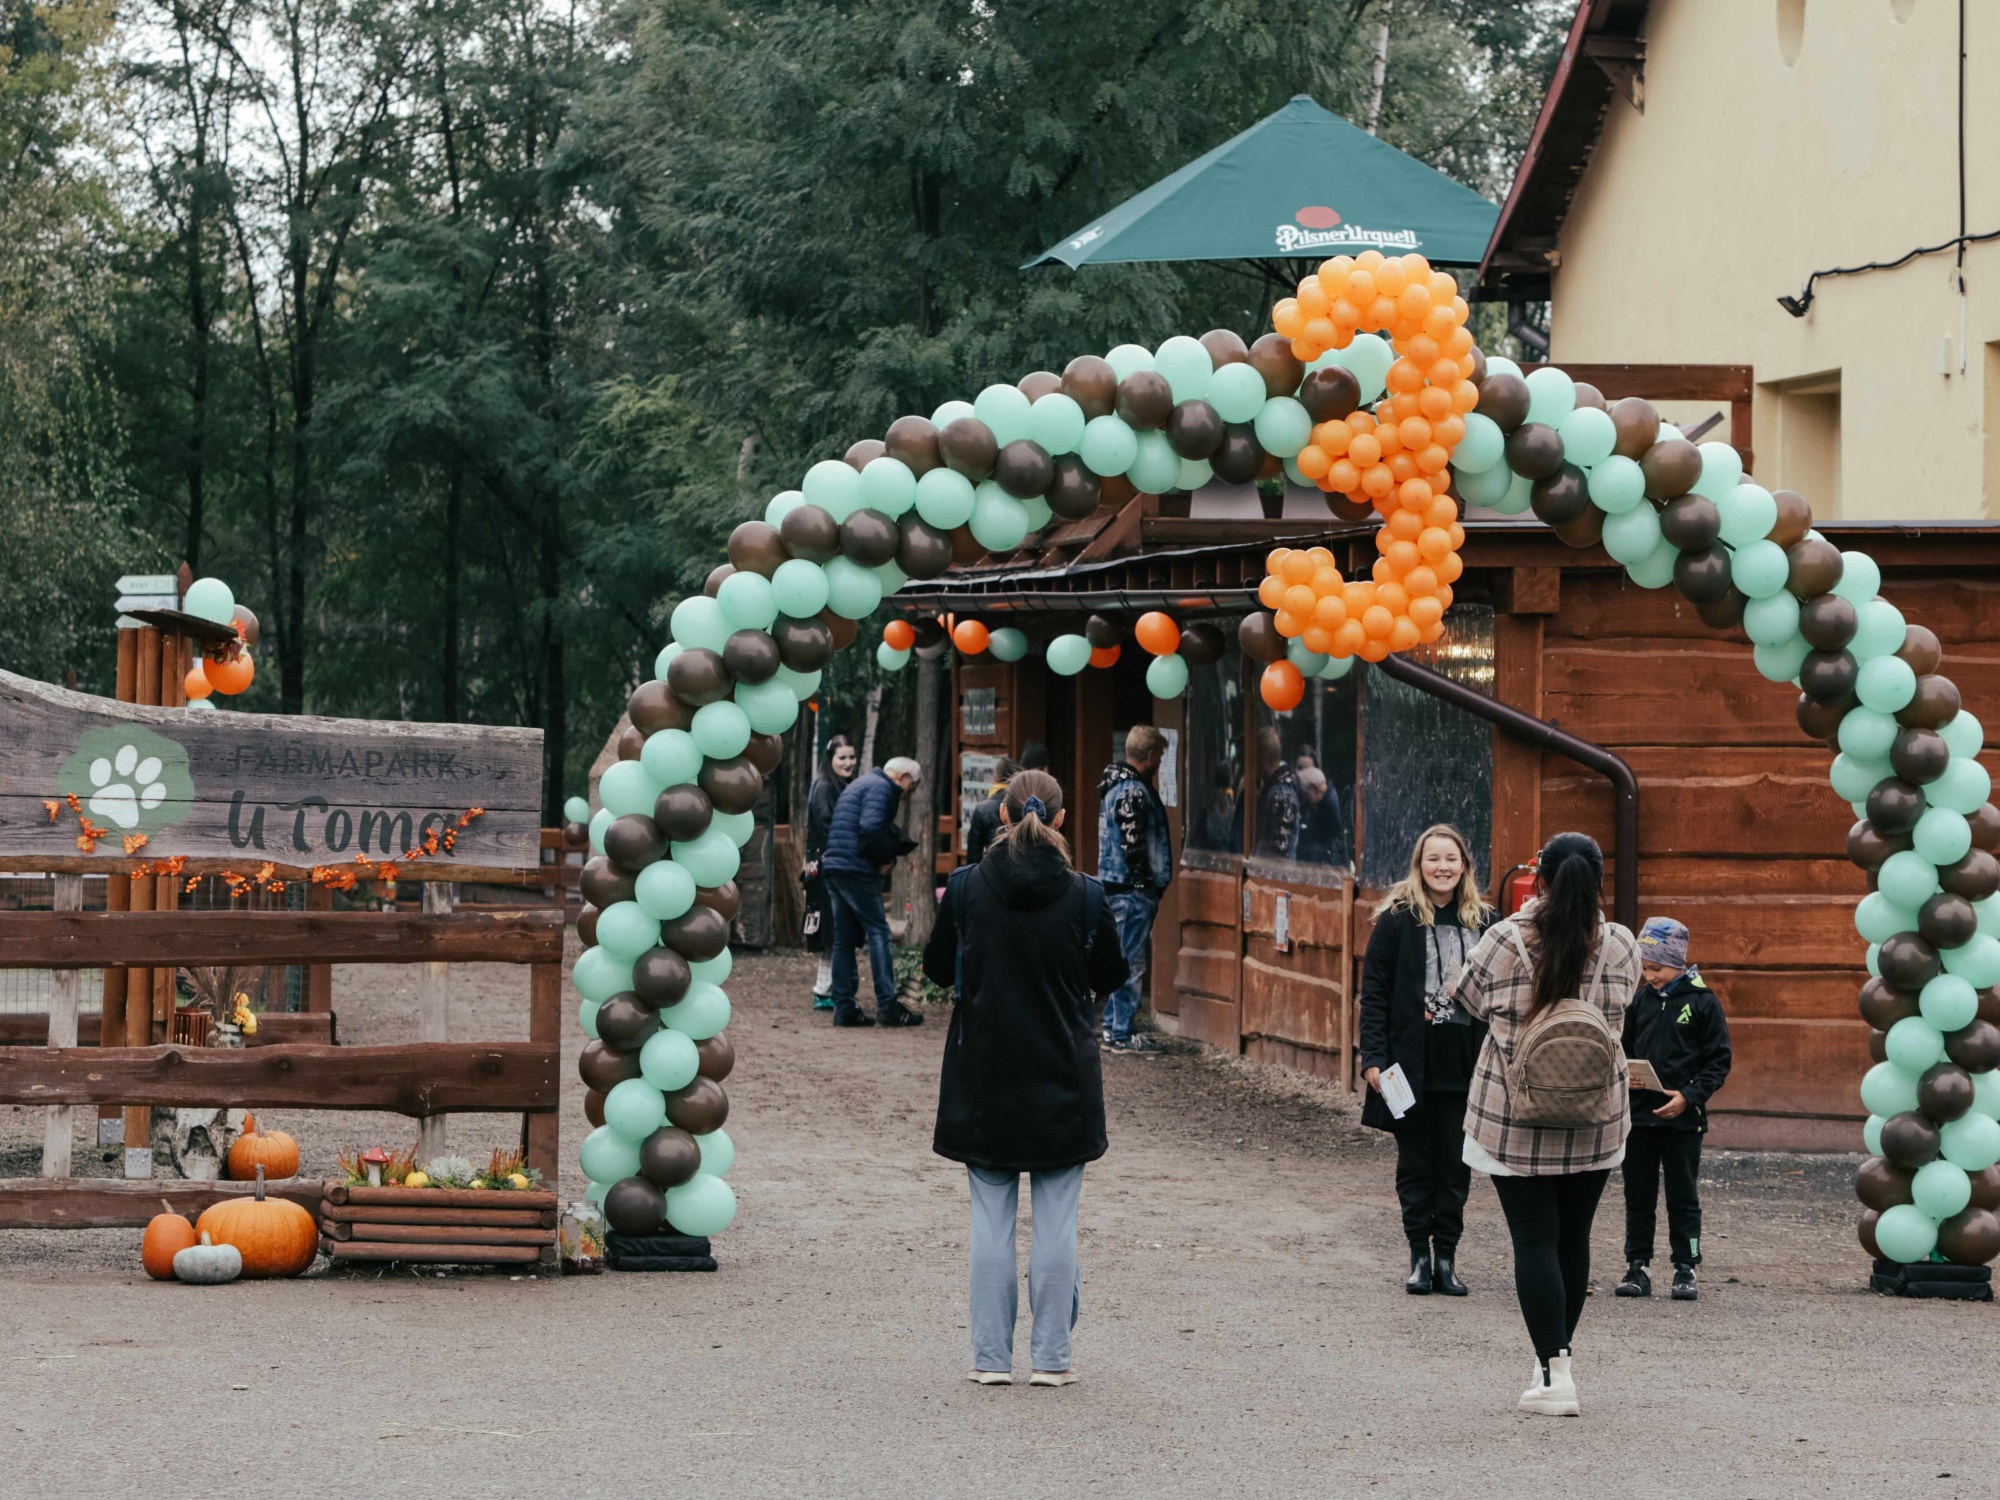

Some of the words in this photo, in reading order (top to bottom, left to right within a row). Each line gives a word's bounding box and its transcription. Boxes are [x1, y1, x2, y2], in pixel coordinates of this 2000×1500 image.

[1275, 224, 1347, 251] Pilsner
[1344, 224, 1417, 248] Urquell
[235, 744, 457, 779] FARMAPARK
